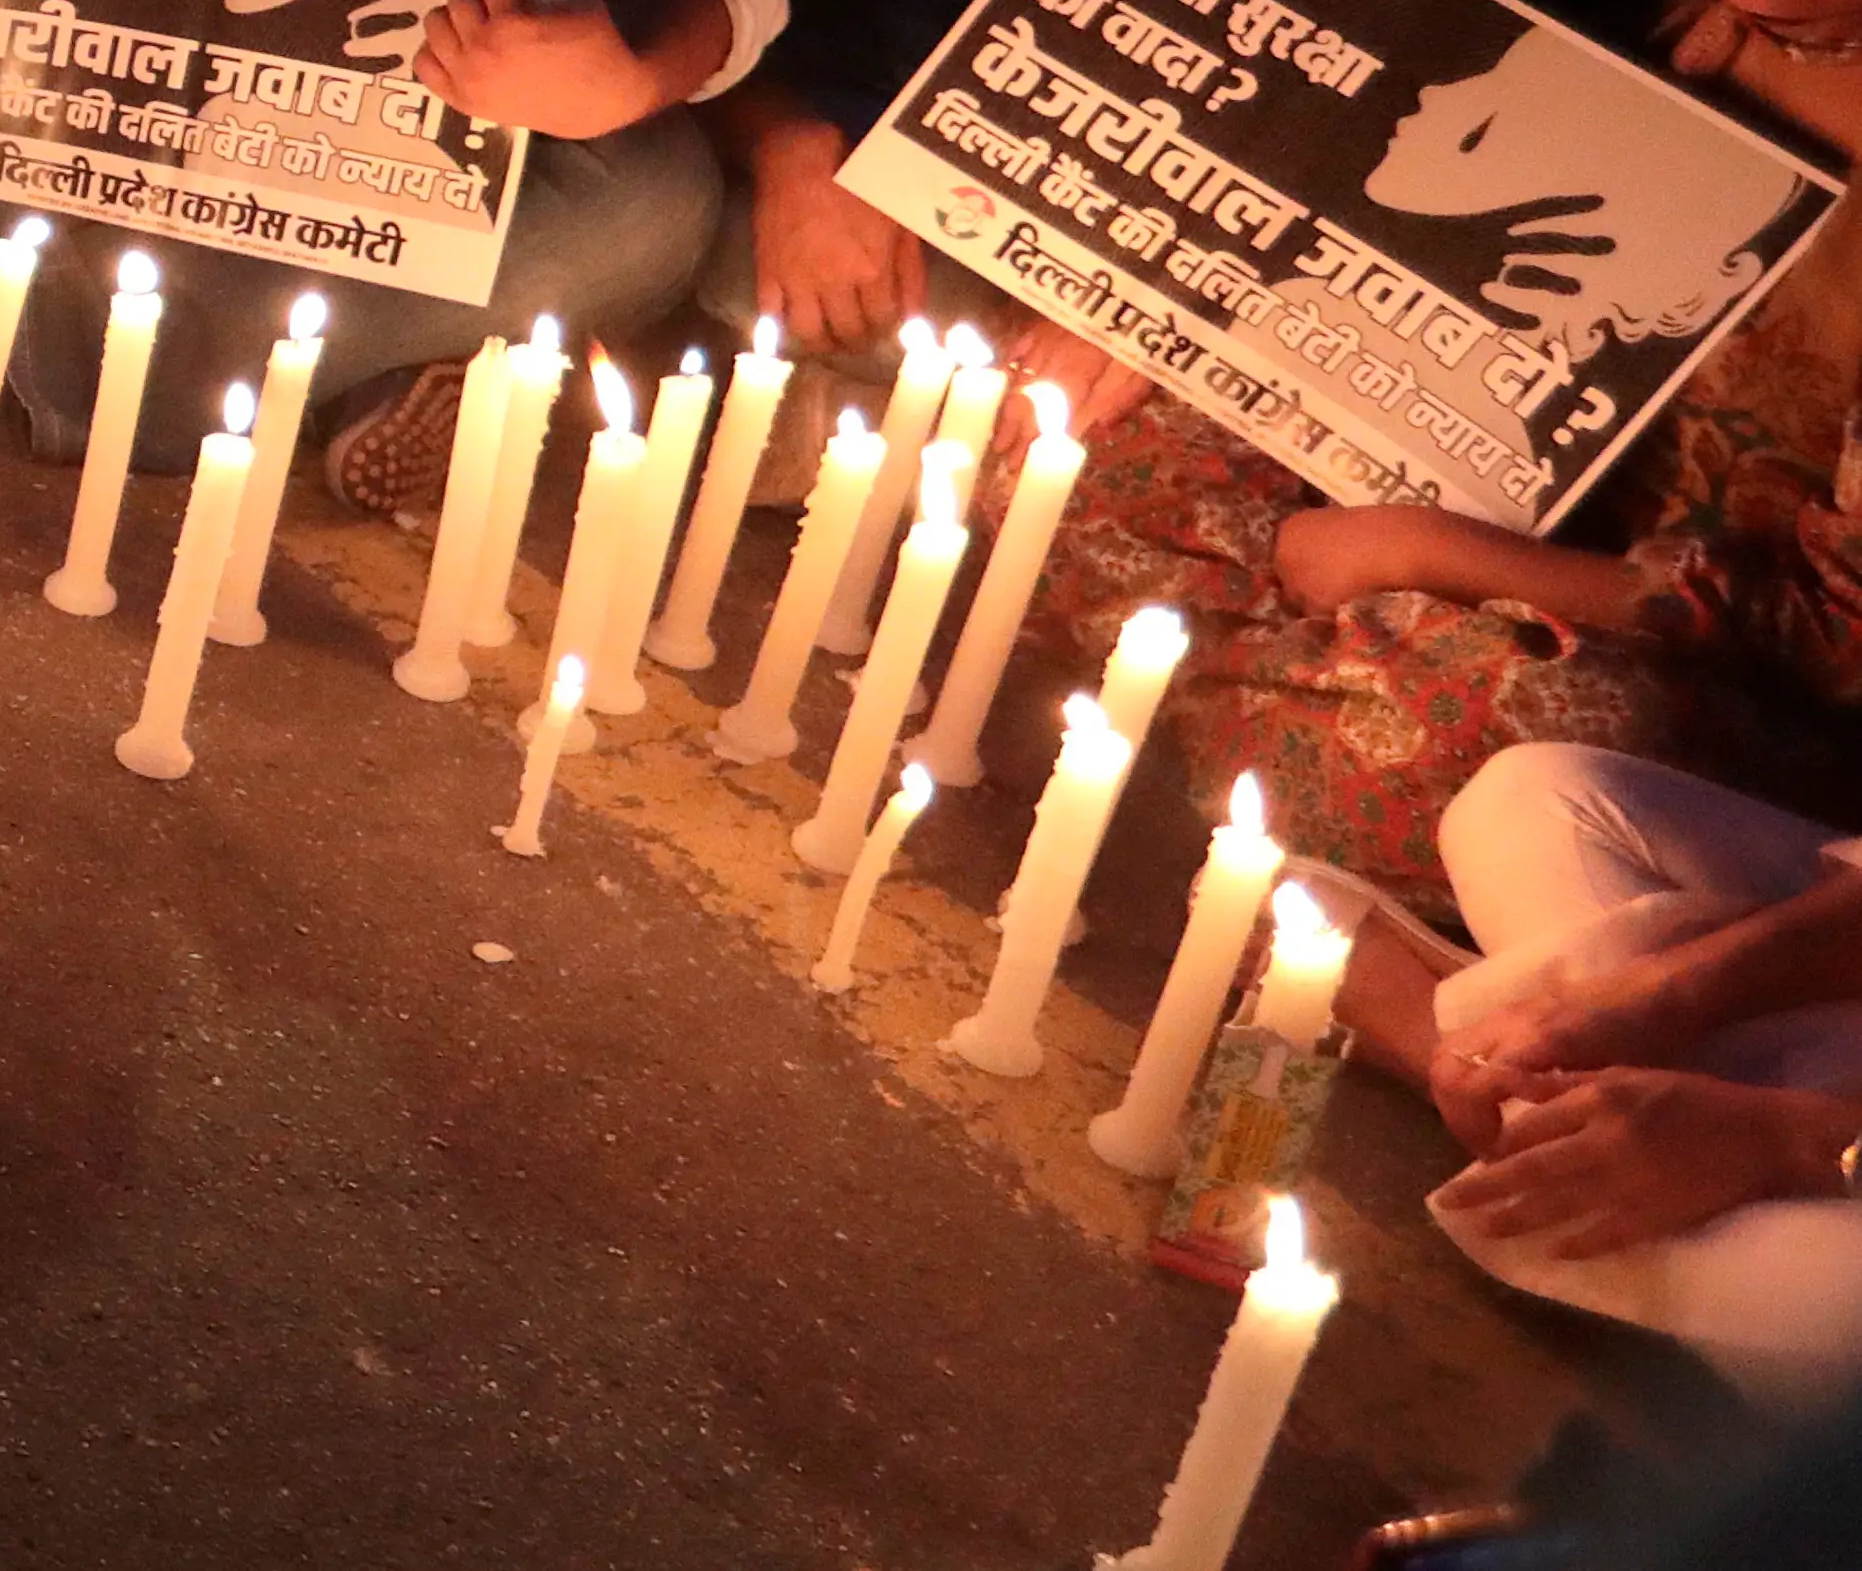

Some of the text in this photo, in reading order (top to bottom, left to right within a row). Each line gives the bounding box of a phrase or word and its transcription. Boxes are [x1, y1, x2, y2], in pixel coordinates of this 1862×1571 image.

[0, 71, 61, 124] कैंट
[64, 87, 114, 132] की
[118, 99, 206, 154] दलित
[213, 115, 280, 168] बेटी
[279, 133, 337, 180] को
[338, 149, 441, 202] न्याय
[442, 164, 490, 212] दो
[204, 42, 376, 125] जवाब
[98, 168, 179, 219] प्रदेश
[181, 191, 292, 243] कांग्रेस
[296, 216, 407, 266] कमेटी
[921, 85, 1054, 185] दिल्ली
[1037, 150, 1121, 231] कैंट
[1106, 198, 1177, 262] की
[1165, 235, 1286, 328] दलित
[1276, 299, 1362, 374] बेटी
[1349, 351, 1419, 412] को
[1405, 388, 1511, 478] न्याय
[1498, 453, 1555, 507] दो
[969, 17, 1310, 252] केजरीवाल
[1293, 216, 1502, 370] जवाब
[1482, 331, 1574, 420] दो
[992, 223, 1117, 319] दिल्ली
[1106, 299, 1208, 374] प्रदेश
[1204, 356, 1334, 454] कांग्रेस
